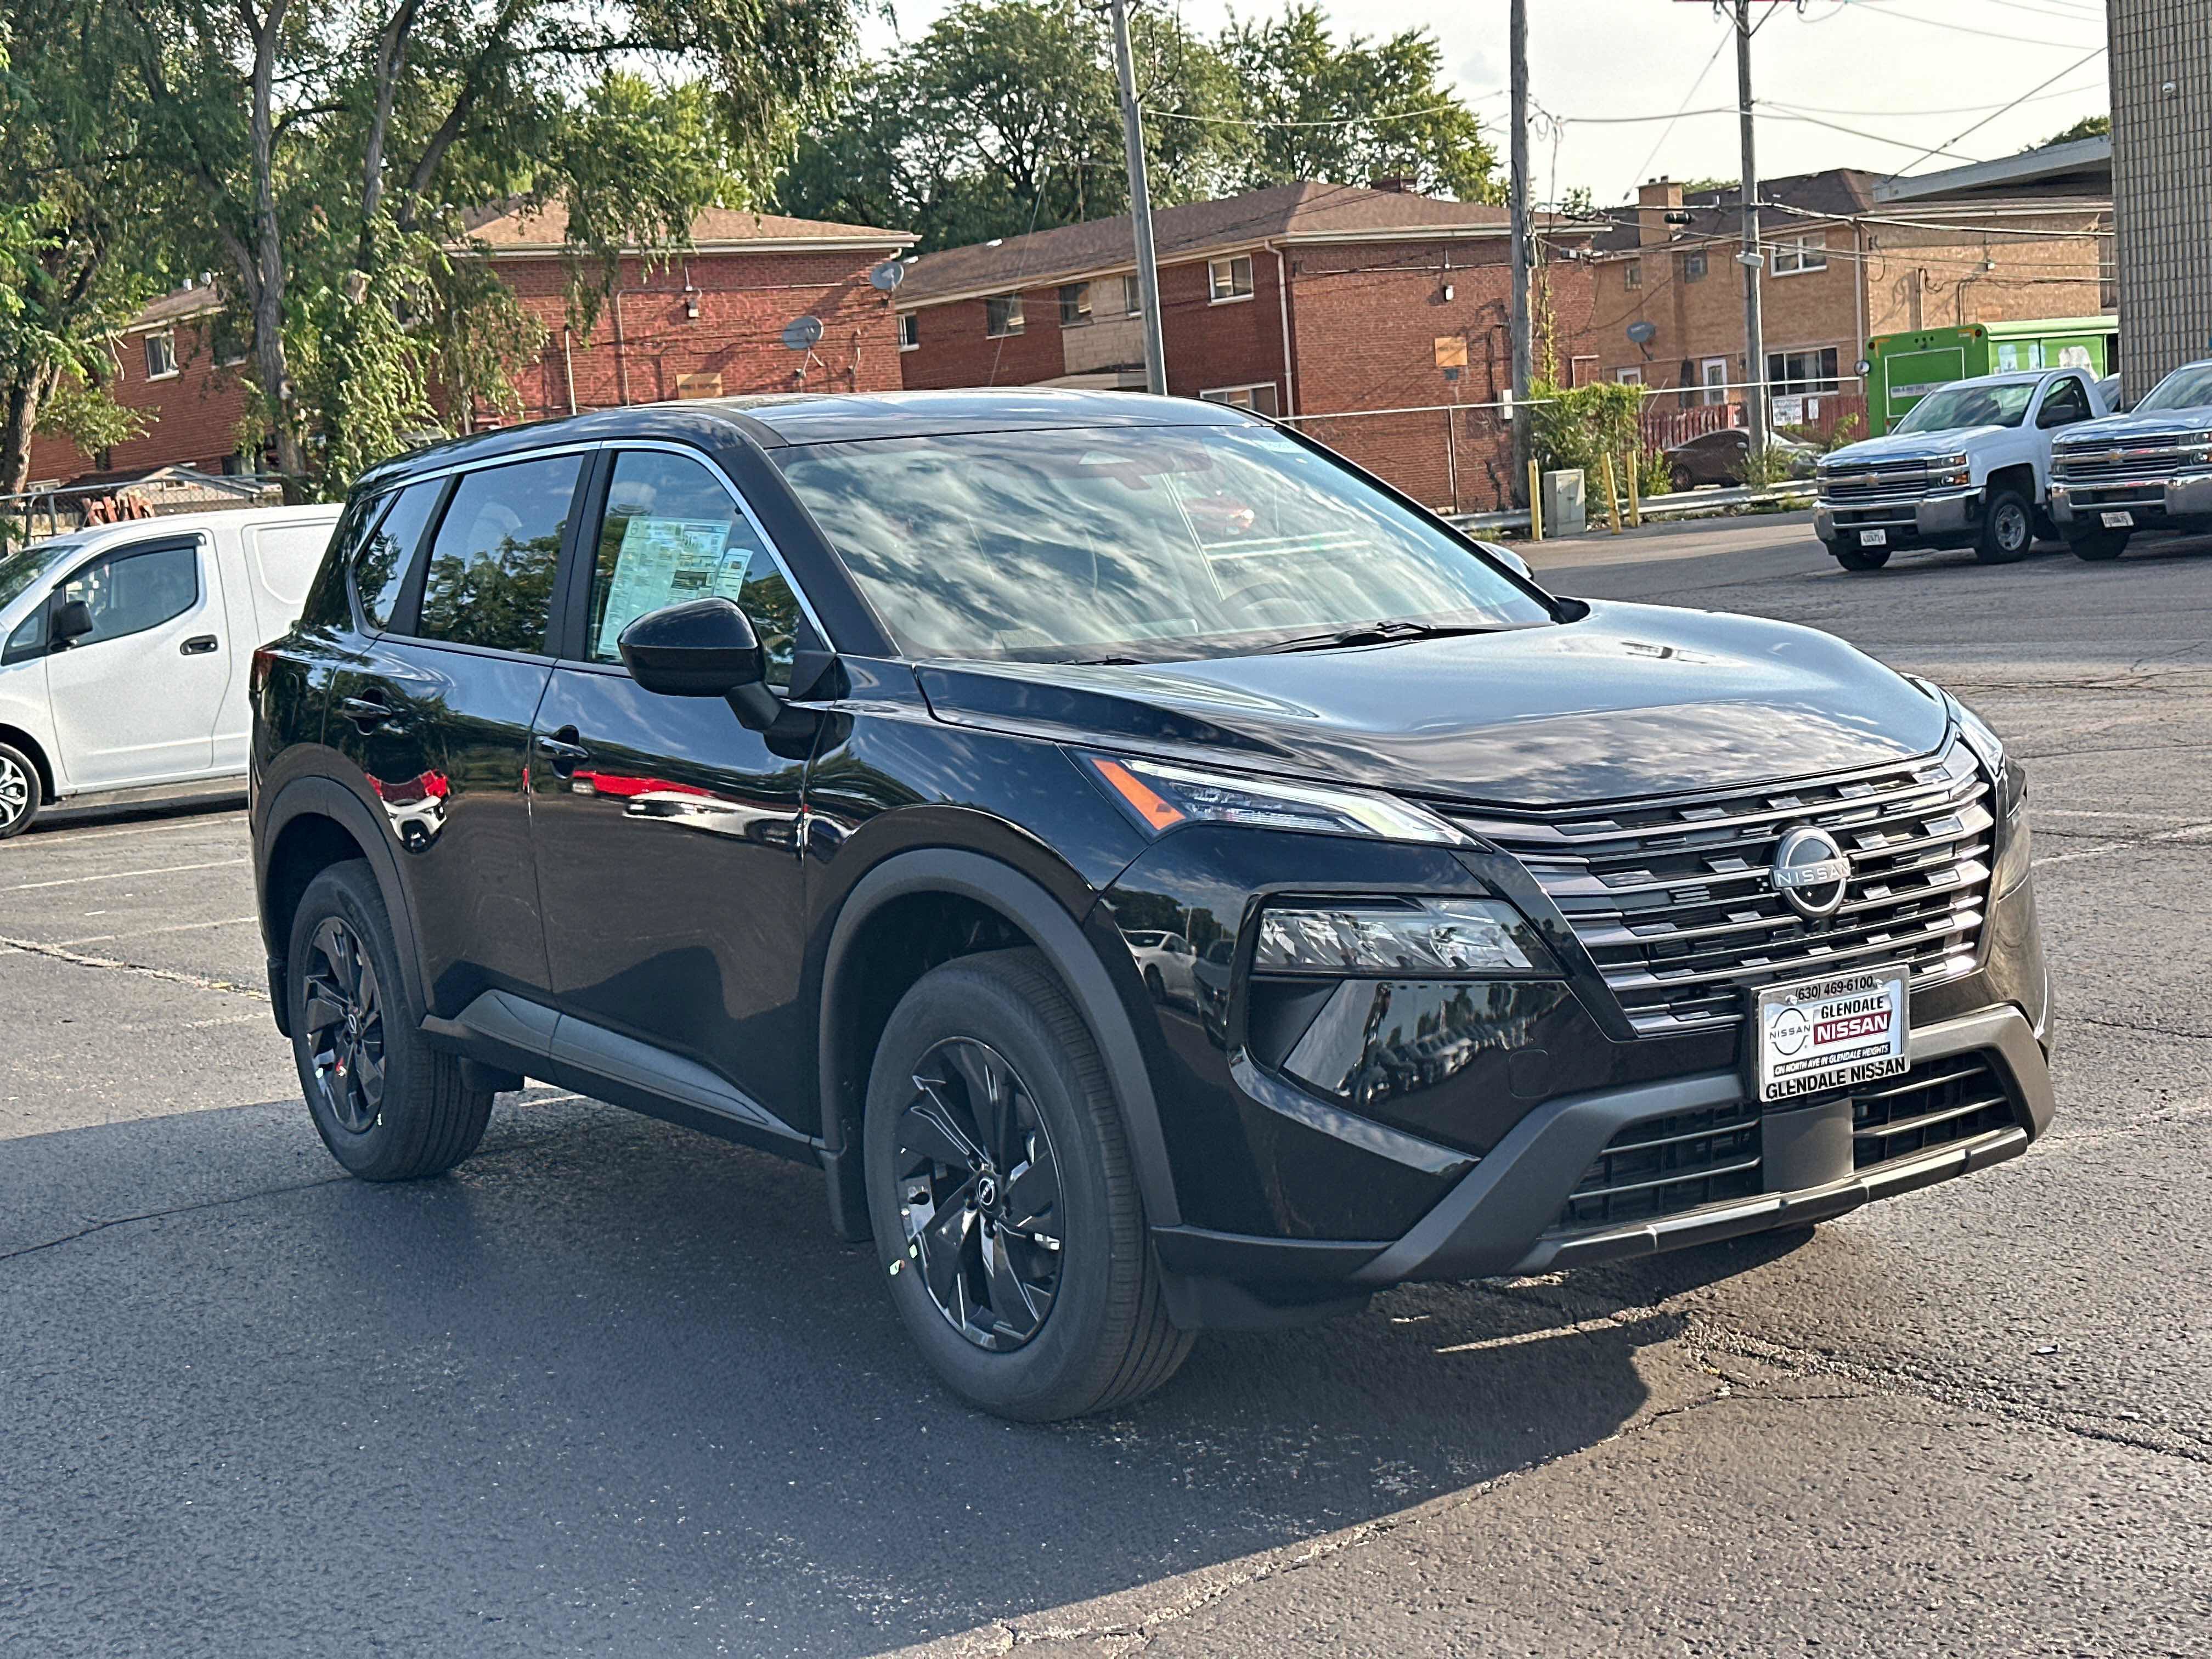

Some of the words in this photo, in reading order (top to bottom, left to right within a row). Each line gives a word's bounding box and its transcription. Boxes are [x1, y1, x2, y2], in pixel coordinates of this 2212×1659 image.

[1777, 864, 1851, 885] NISSAN
[1795, 987, 1821, 1001] (630)
[1824, 975, 1874, 996] 469-6100
[1821, 996, 1884, 1019] GLENDALE
[1769, 1024, 1810, 1040] NISSAN
[1817, 1014, 1888, 1042] NISSAN
[1775, 1065, 1785, 1075] ON
[1808, 1057, 1820, 1068] AVE
[1821, 1056, 1829, 1065] IN
[1829, 1049, 1861, 1064] GLENDALE
[1862, 1044, 1889, 1058] HEIGHTS
[1765, 1069, 1847, 1099] GLENDALE
[1850, 1057, 1906, 1082] NISSAN
